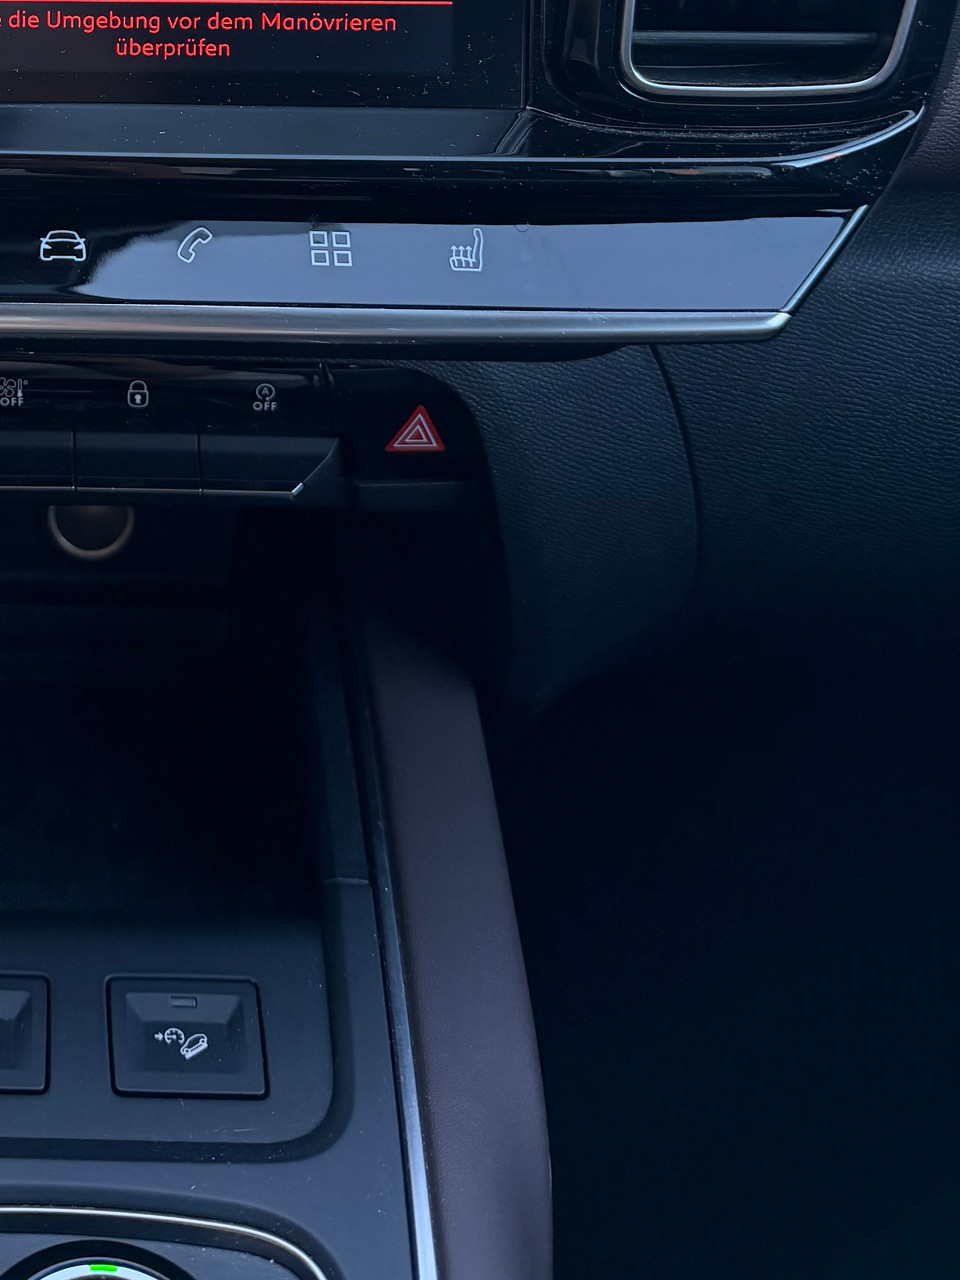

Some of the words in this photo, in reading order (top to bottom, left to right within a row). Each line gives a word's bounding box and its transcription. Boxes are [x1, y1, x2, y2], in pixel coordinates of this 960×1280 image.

[7, 11, 40, 30] die
[46, 11, 160, 33] Umgebung
[167, 17, 201, 30] vor
[207, 12, 253, 31] dem
[261, 12, 396, 32] Manövrieren
[116, 39, 230, 60] überprüfen
[0, 397, 24, 407] OFF
[252, 401, 277, 412] OFF
